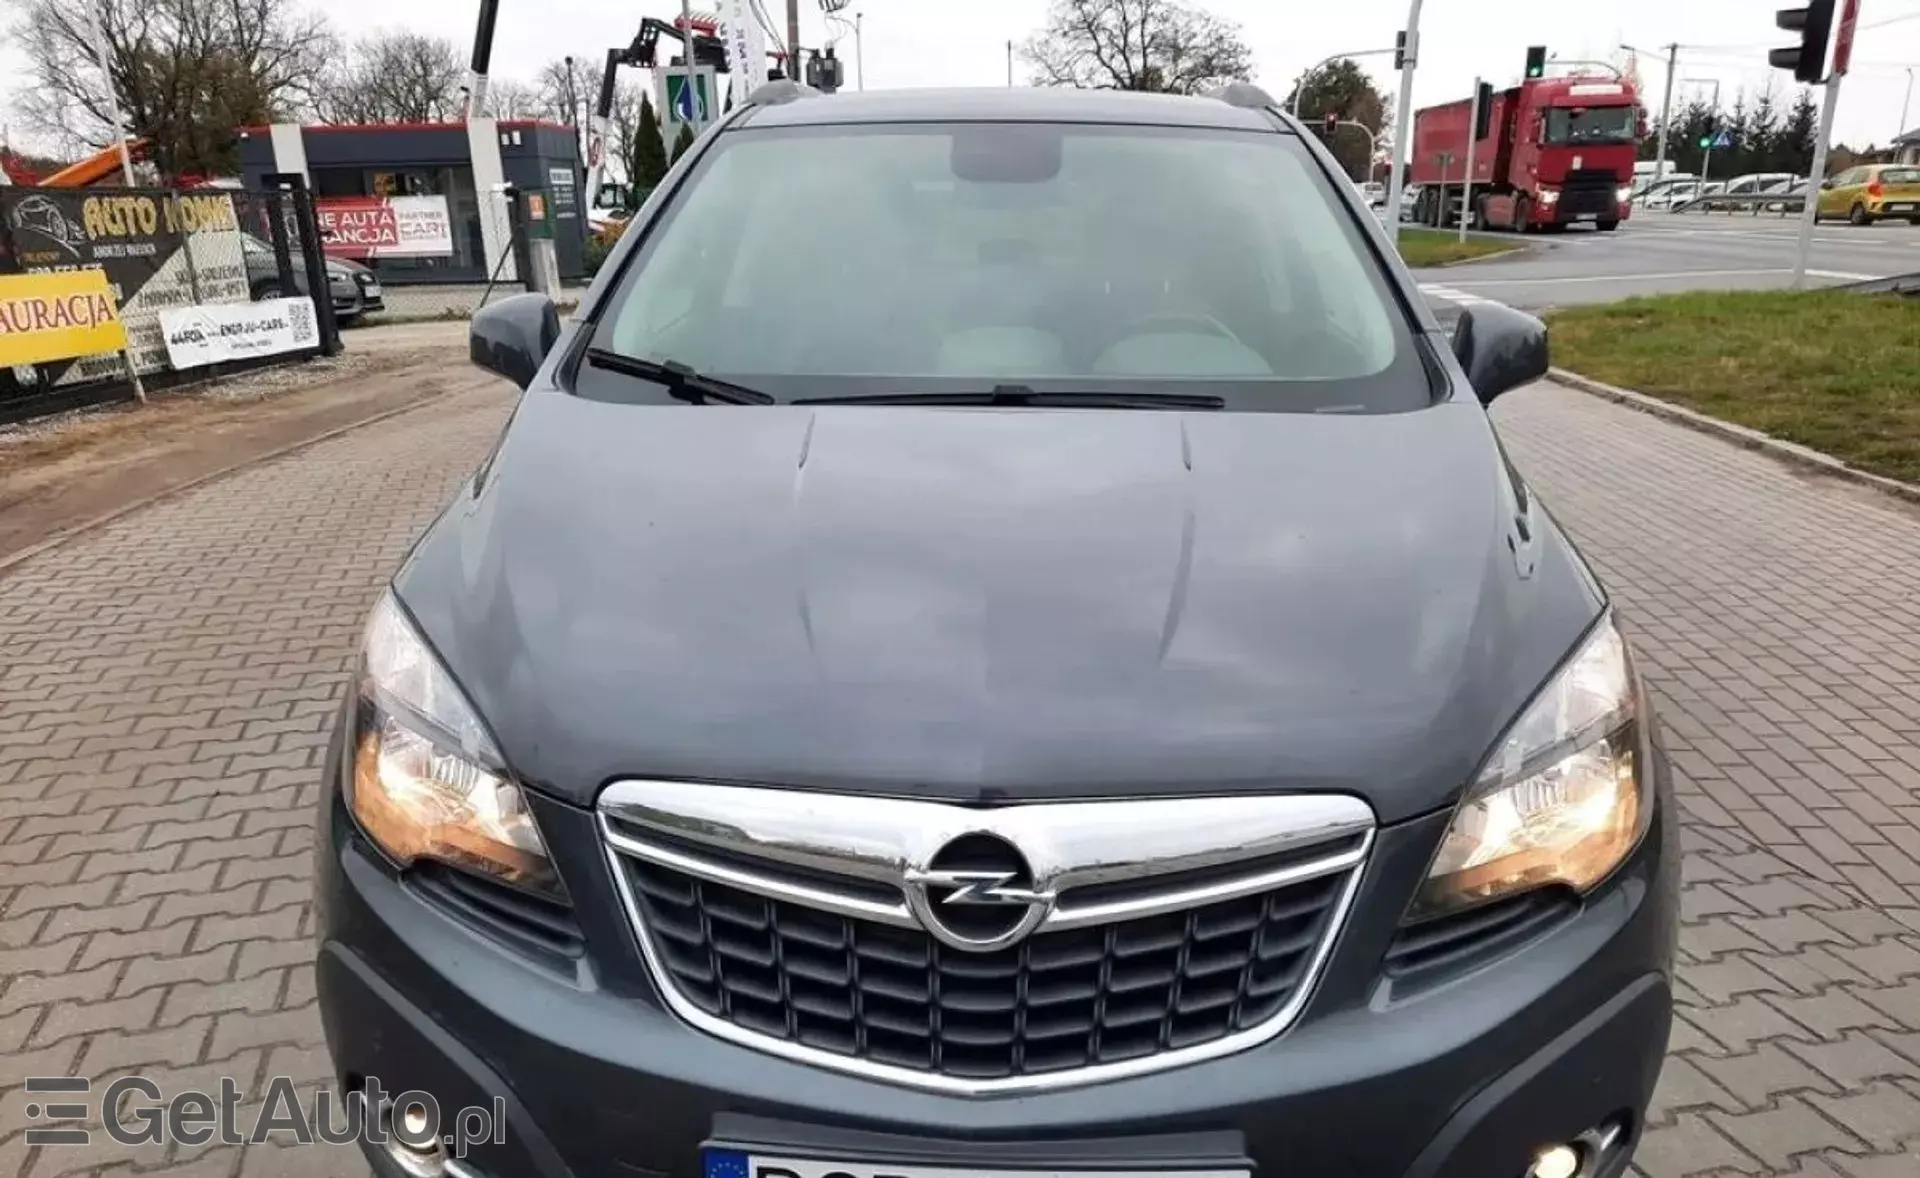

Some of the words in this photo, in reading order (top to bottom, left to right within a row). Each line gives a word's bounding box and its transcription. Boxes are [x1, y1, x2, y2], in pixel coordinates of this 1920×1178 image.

[83, 196, 157, 241] AUTO
[341, 211, 395, 227] AUTA
[322, 228, 396, 244] ANCJA
